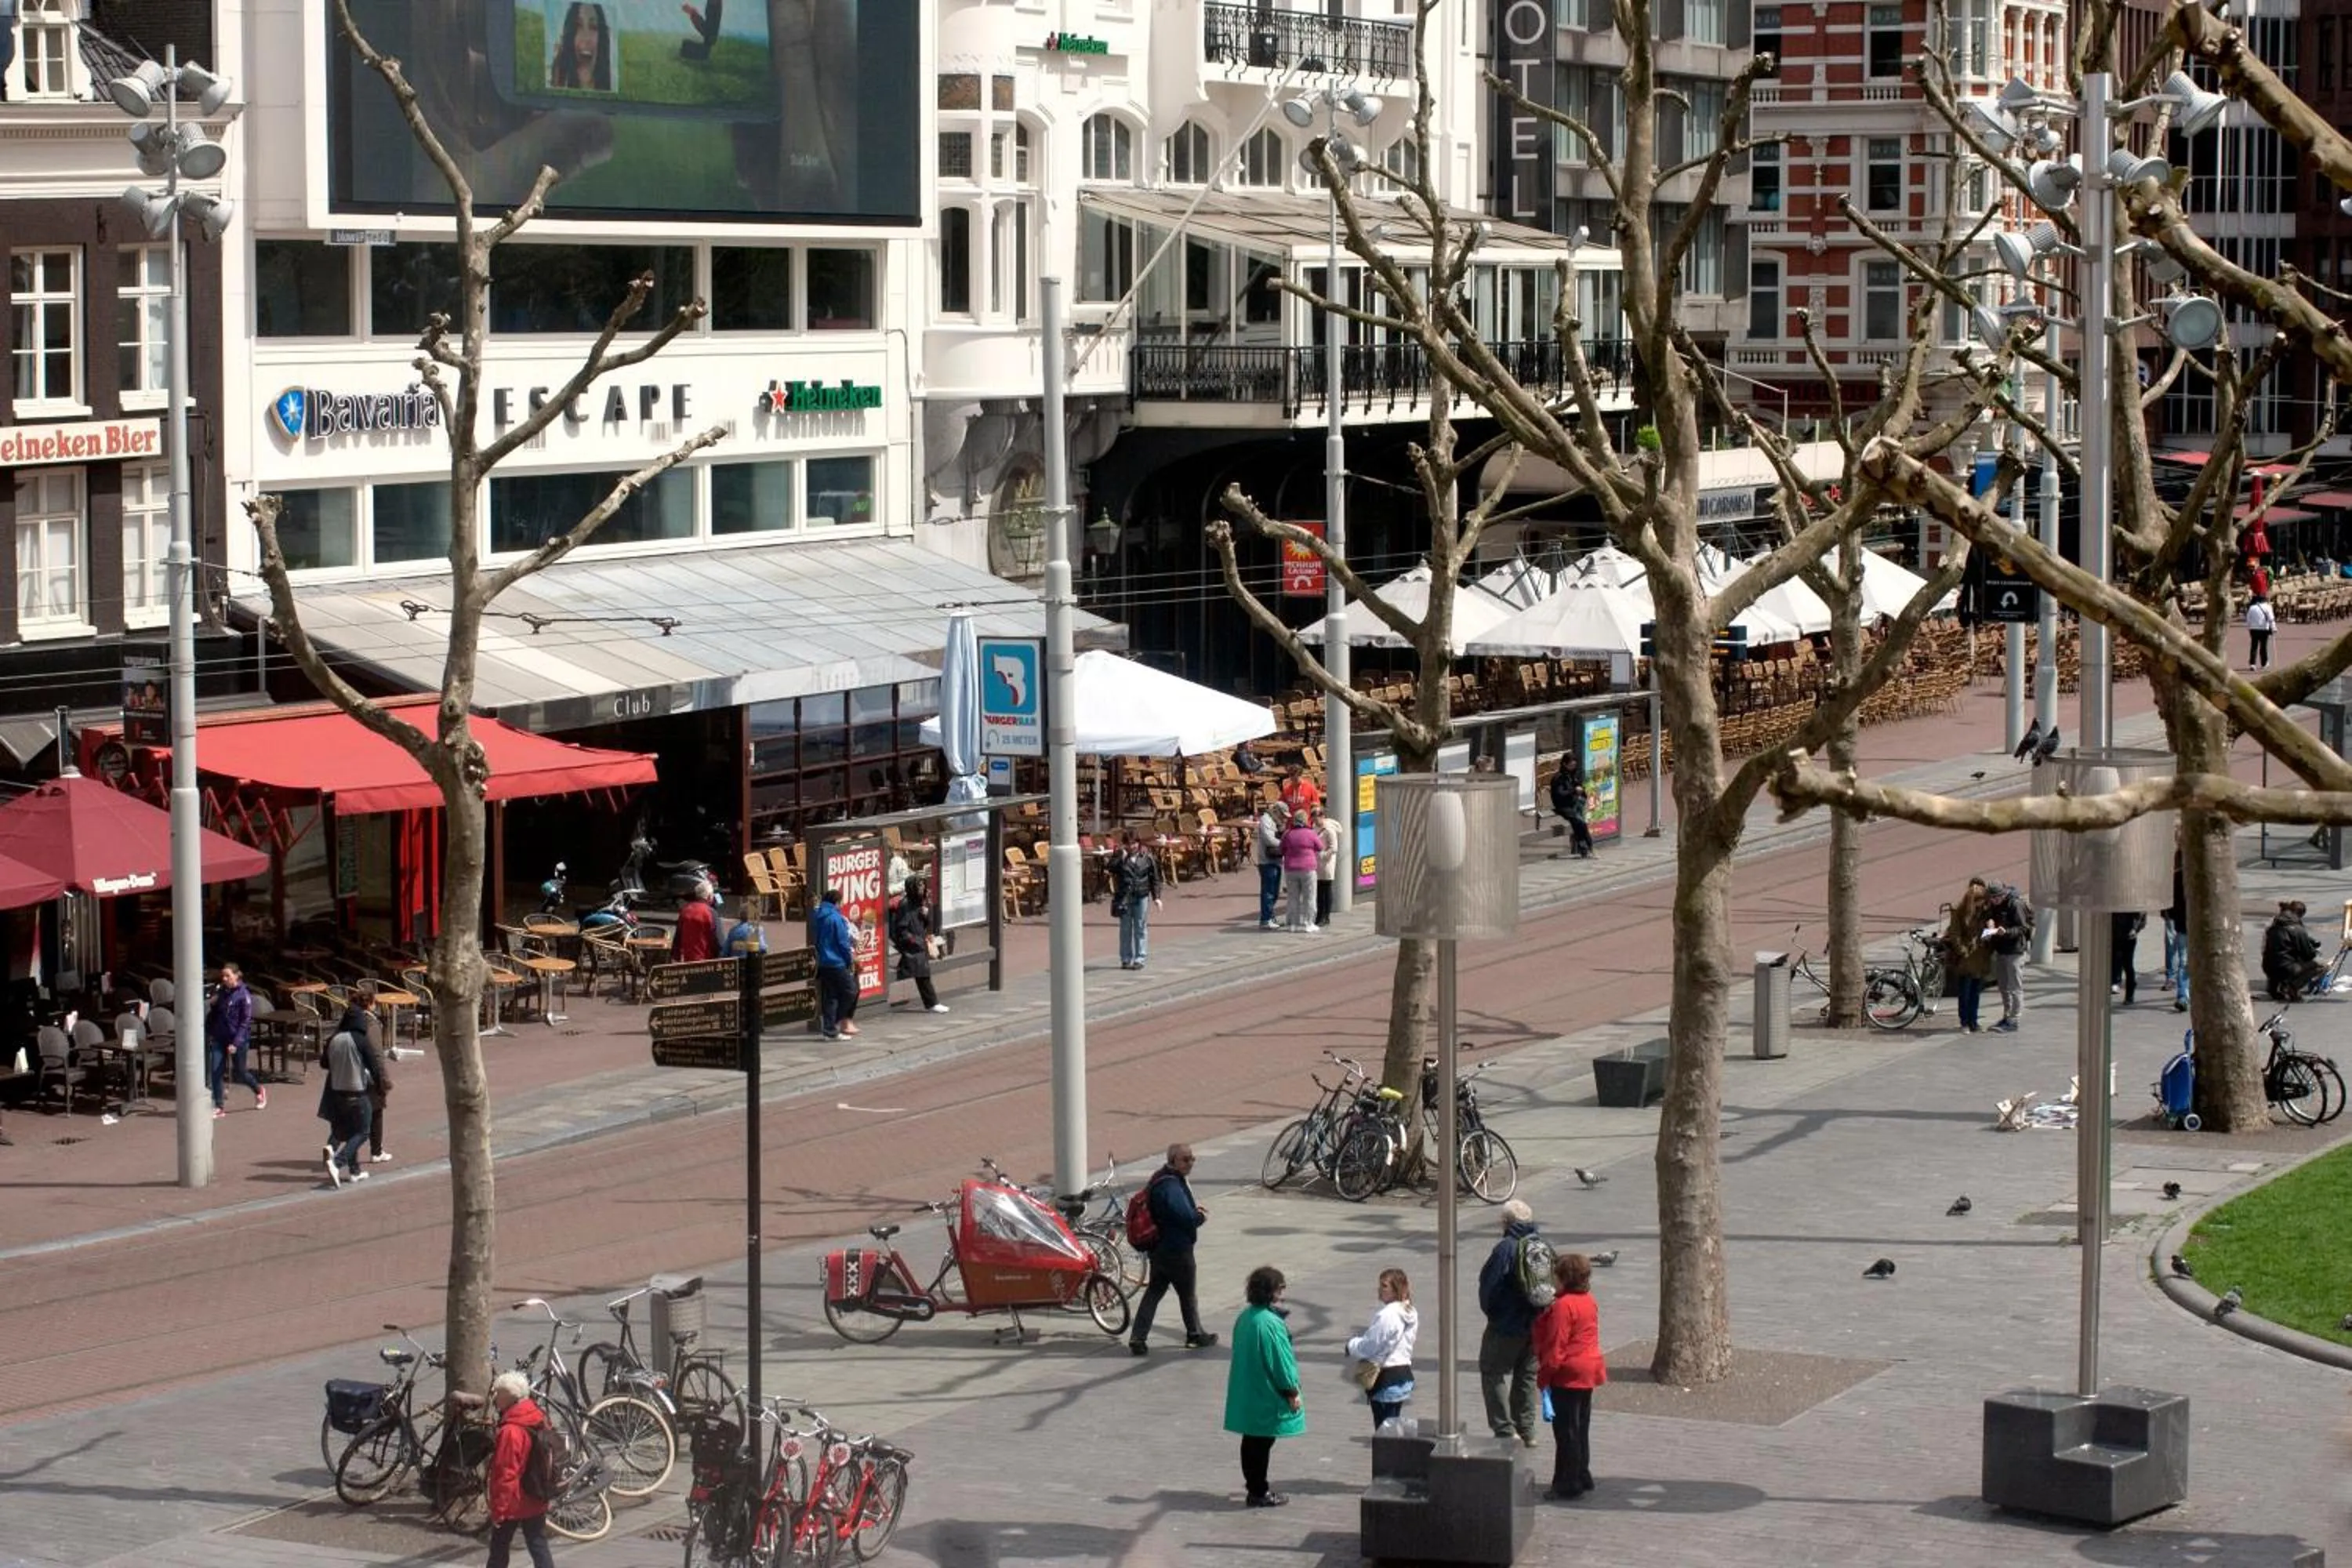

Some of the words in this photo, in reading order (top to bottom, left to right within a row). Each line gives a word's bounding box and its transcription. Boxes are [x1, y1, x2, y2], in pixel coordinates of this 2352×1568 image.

[1058, 32, 1108, 55] Heineken
[1504, 0, 1546, 218] OTEL
[305, 387, 440, 440] Bavaria
[493, 383, 692, 426] ESCAPE
[788, 380, 883, 412] Heineken
[0, 430, 102, 462] eineken
[104, 424, 157, 454] Bier
[614, 693, 650, 717] Club
[828, 849, 880, 876] BURGER
[827, 869, 880, 904] KING
